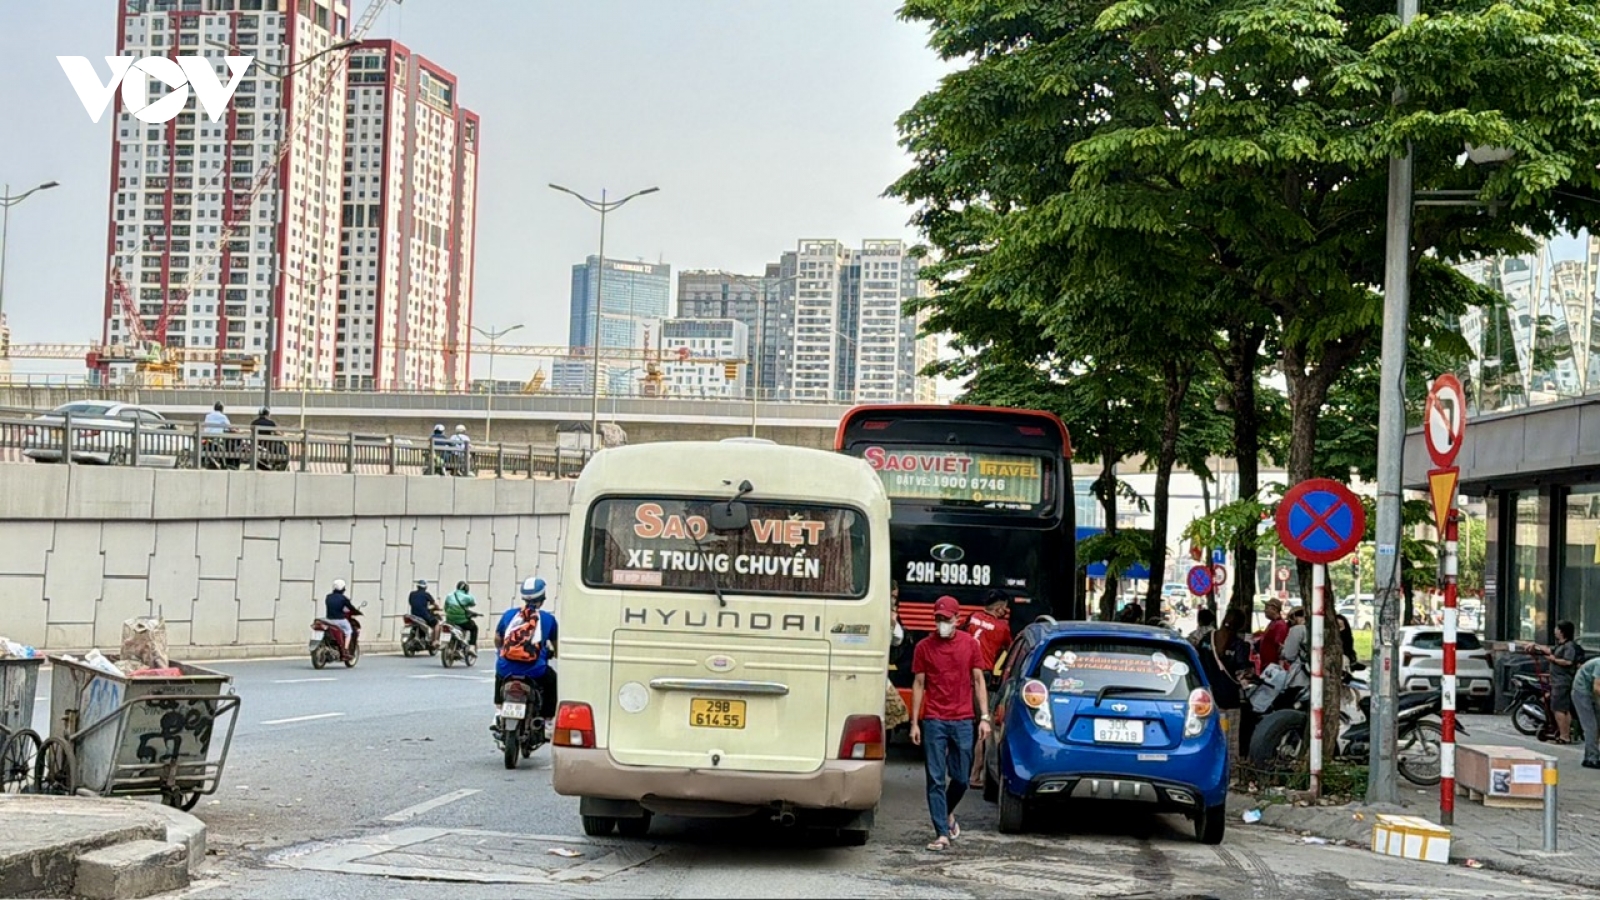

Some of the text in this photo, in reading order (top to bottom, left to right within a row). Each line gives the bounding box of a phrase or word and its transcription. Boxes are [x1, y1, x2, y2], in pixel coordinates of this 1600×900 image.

[979, 459, 1039, 479] TRAVEL
[933, 475, 967, 489] 1900
[970, 478, 1006, 491] 6746
[634, 503, 826, 548] SAO VIỆT
[626, 548, 820, 579] XE TRUNG CHUYỂN
[906, 561, 991, 586] 29H-998.98
[624, 607, 821, 632] HYUNDAI
[706, 700, 731, 713] 29B
